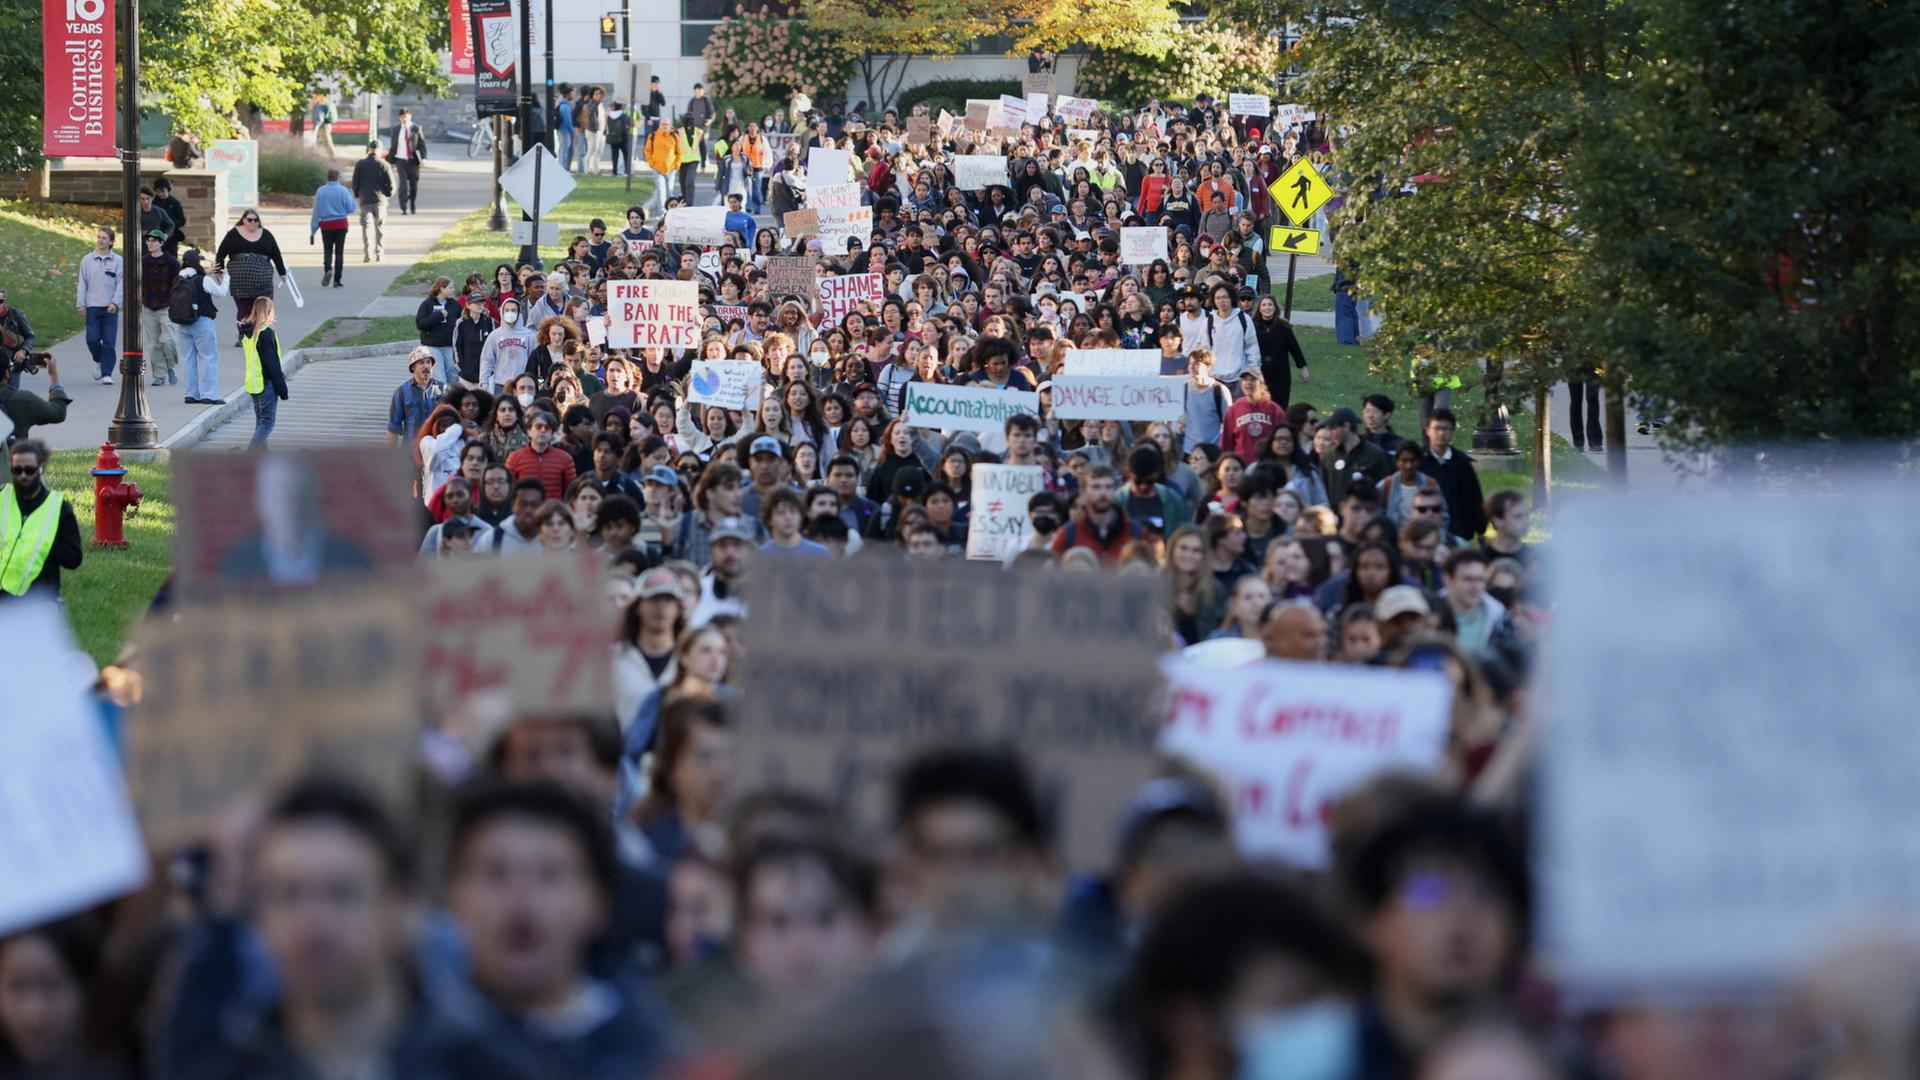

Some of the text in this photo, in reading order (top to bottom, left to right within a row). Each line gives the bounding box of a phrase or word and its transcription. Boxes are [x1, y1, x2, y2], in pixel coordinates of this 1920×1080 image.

[66, 0, 105, 21] 10
[65, 23, 104, 34] YEARS
[65, 40, 88, 122] Cornell
[479, 72, 492, 80] 100
[85, 39, 103, 136] Business
[479, 78, 511, 89] Years of
[816, 214, 846, 224] Whose
[852, 223, 869, 235] Our
[616, 285, 649, 298] FIRE
[768, 285, 808, 294] WOMEN
[820, 274, 882, 299] SHAME
[624, 302, 693, 323] BAN THE
[633, 323, 694, 345] FRATS
[498, 337, 527, 350] CORNELL
[1054, 384, 1180, 408] DAMAGE CONTROL
[1236, 412, 1272, 428] CORNELL
